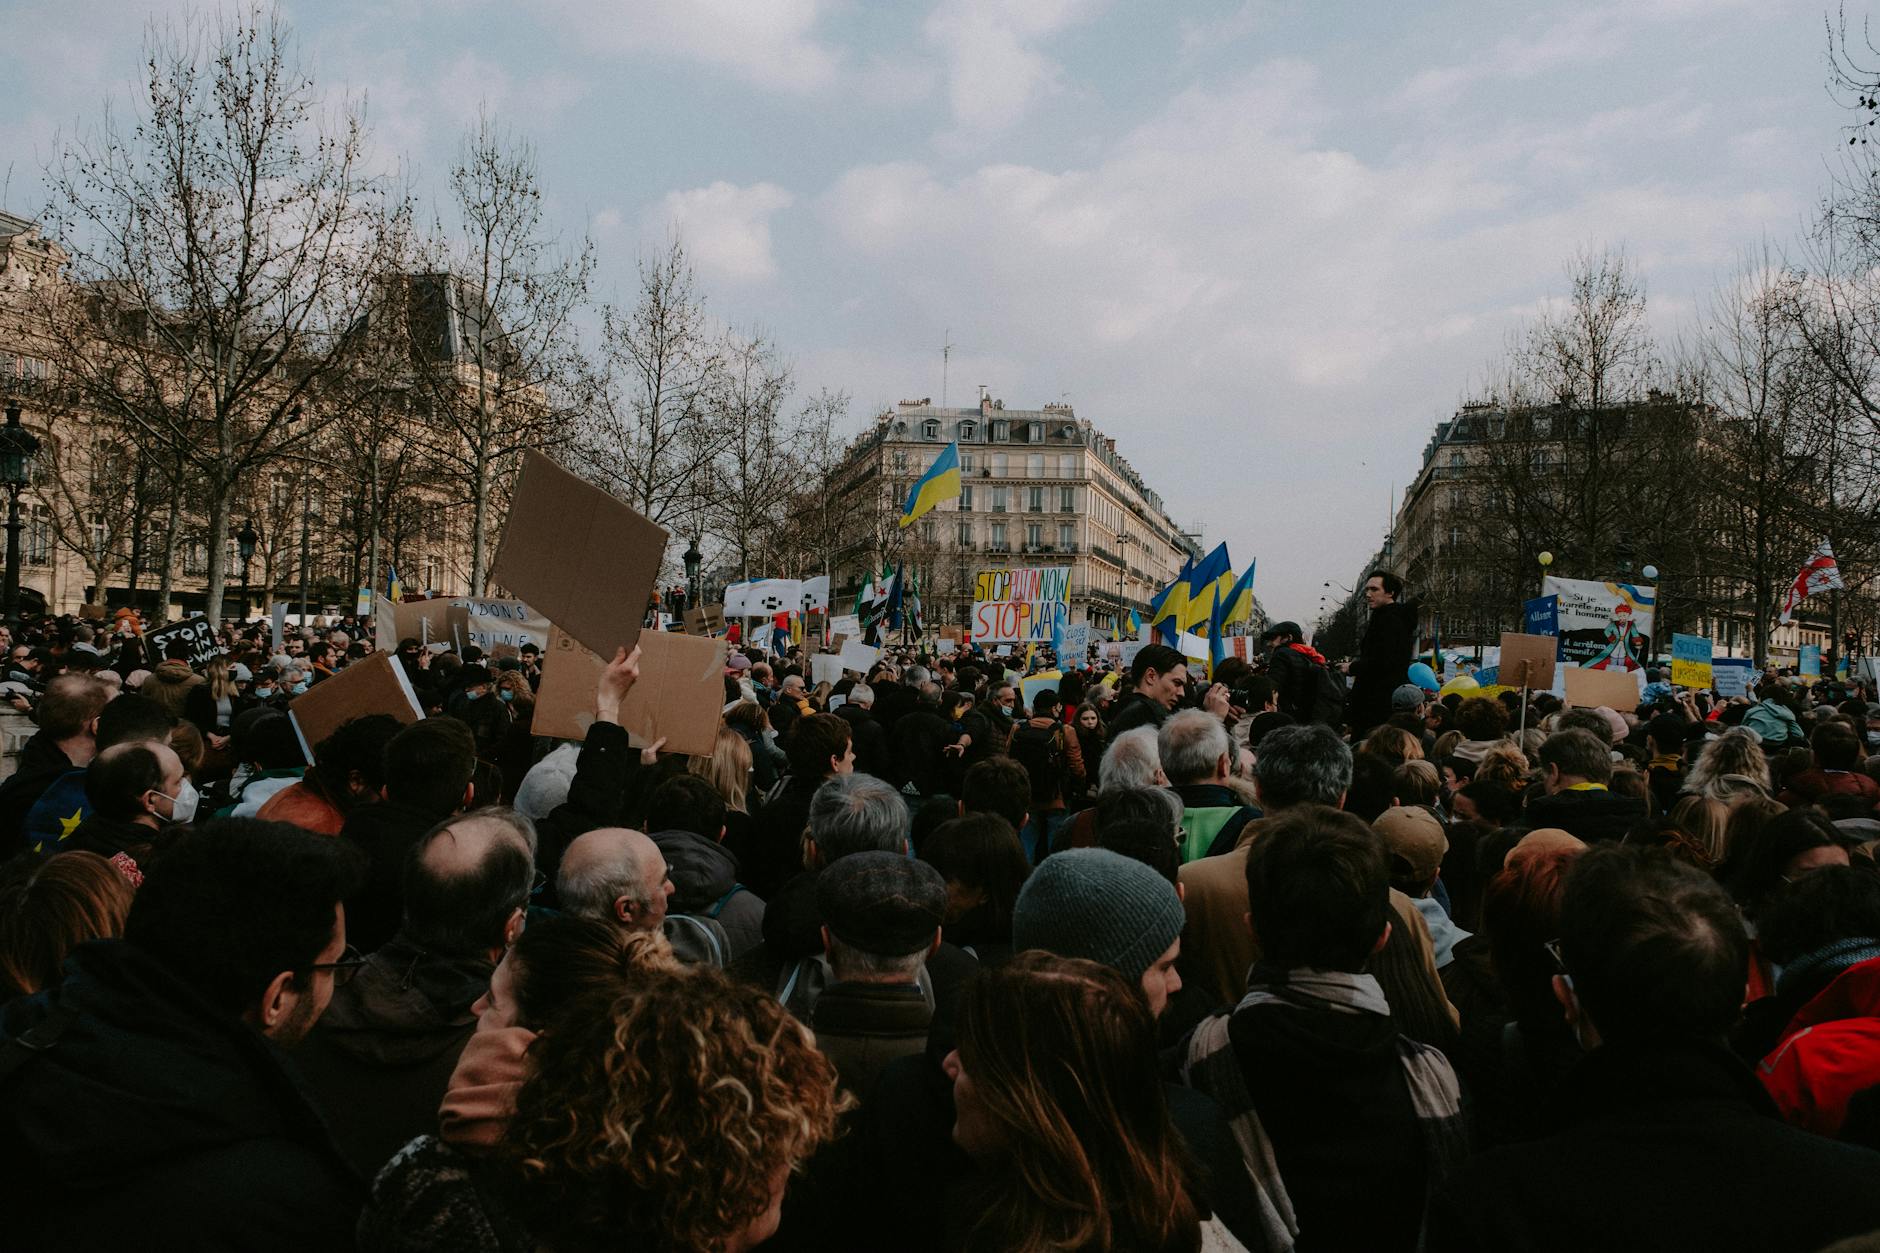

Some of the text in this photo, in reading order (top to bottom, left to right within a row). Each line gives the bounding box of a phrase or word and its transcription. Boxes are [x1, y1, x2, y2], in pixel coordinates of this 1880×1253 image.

[976, 568, 1071, 602] STOP PUTIN NOW
[975, 602, 1031, 639] STOP
[1594, 606, 1612, 614] pas
[152, 622, 209, 651] STOP
[1066, 626, 1086, 640] CLOSE
